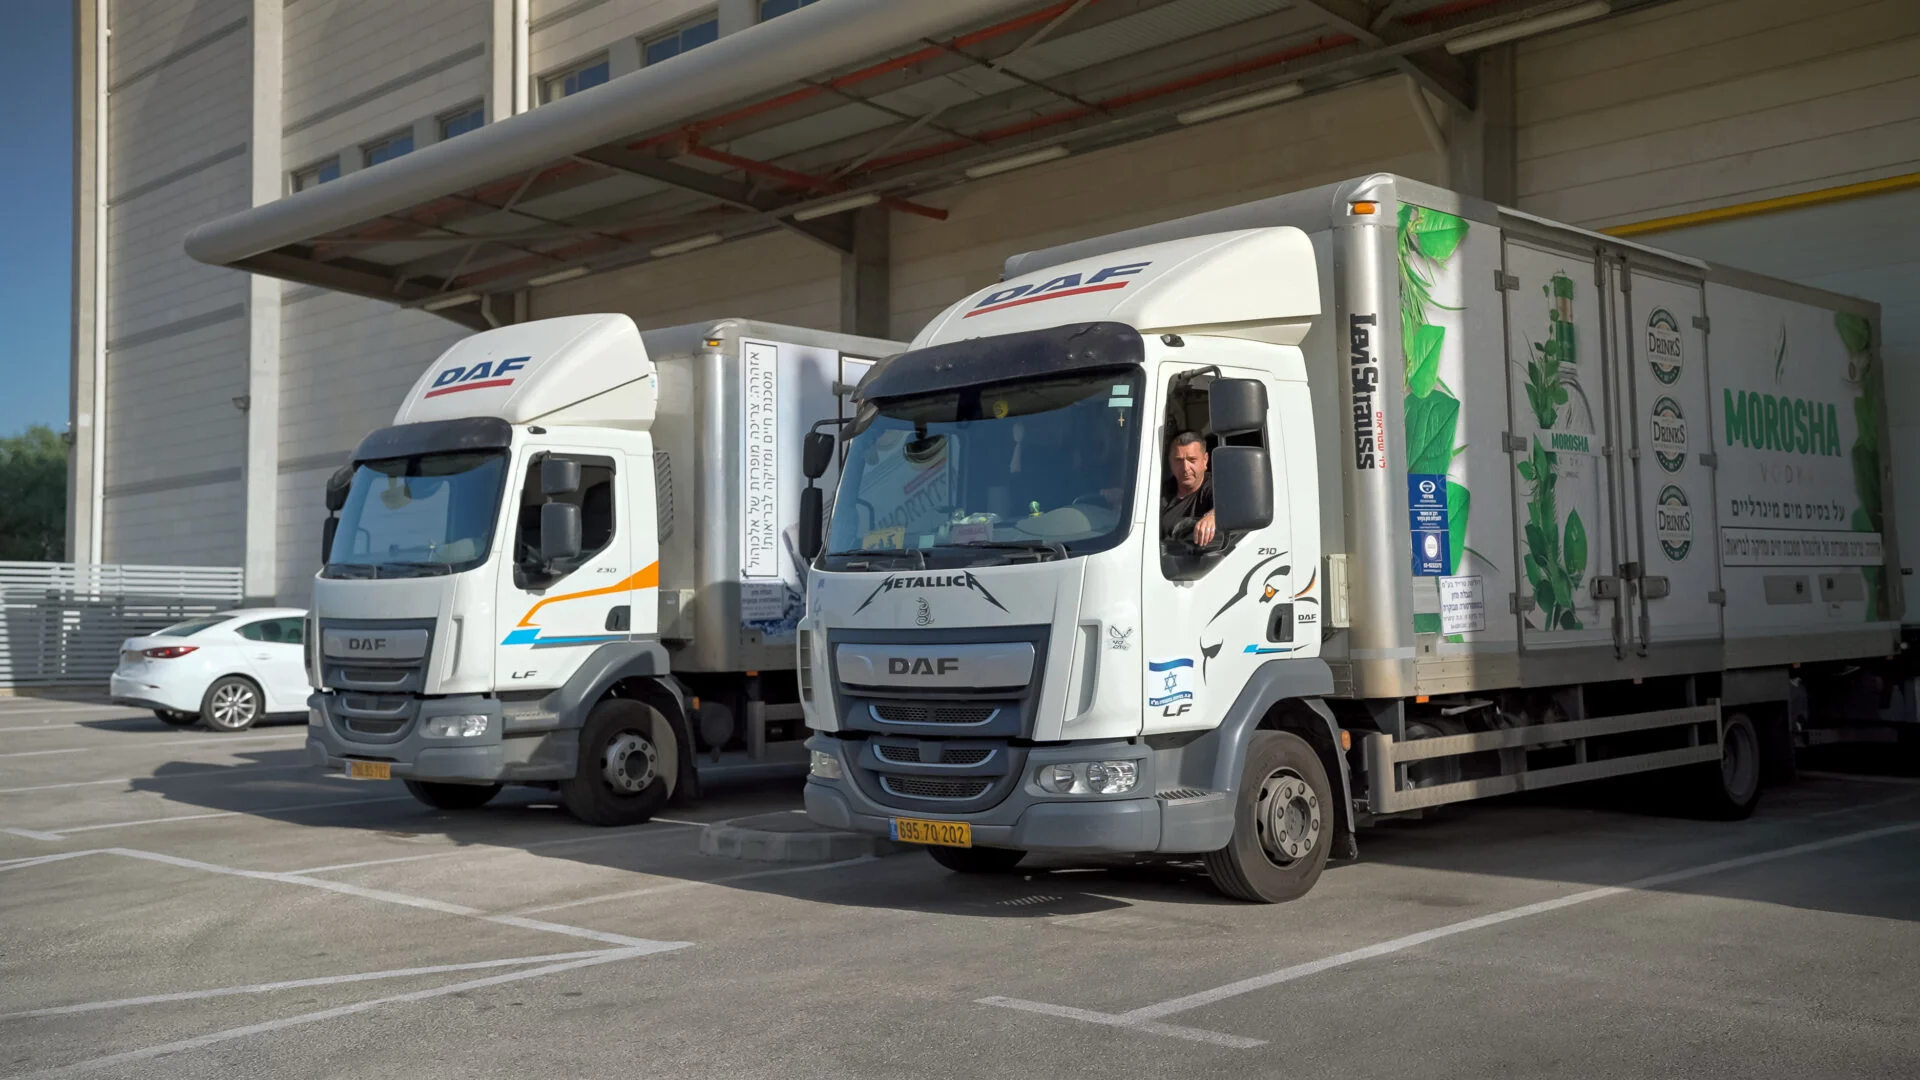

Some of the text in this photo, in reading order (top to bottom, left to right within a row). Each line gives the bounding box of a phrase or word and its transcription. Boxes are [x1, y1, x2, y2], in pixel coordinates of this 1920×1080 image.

[974, 261, 1153, 309] DAF
[1648, 331, 1681, 357] DRINKS
[431, 356, 532, 389] DAF
[1653, 420, 1686, 444] DRINKS
[1723, 387, 1842, 458] MOROSHA
[1551, 432, 1590, 453] MOROSHA
[748, 352, 760, 568] אזהרה: צריכה מופרזת של אלכוהול
[761, 371, 776, 550] מסכנת חיים ומזיקה לבריאות!
[1731, 494, 1846, 522] על בסיס מים מינרליים
[1658, 510, 1691, 532] DRINKS
[1257, 547, 1277, 555] 210
[349, 638, 386, 650] DAF
[511, 670, 538, 679] LF
[888, 657, 960, 675] DAF
[1162, 703, 1193, 718] LF
